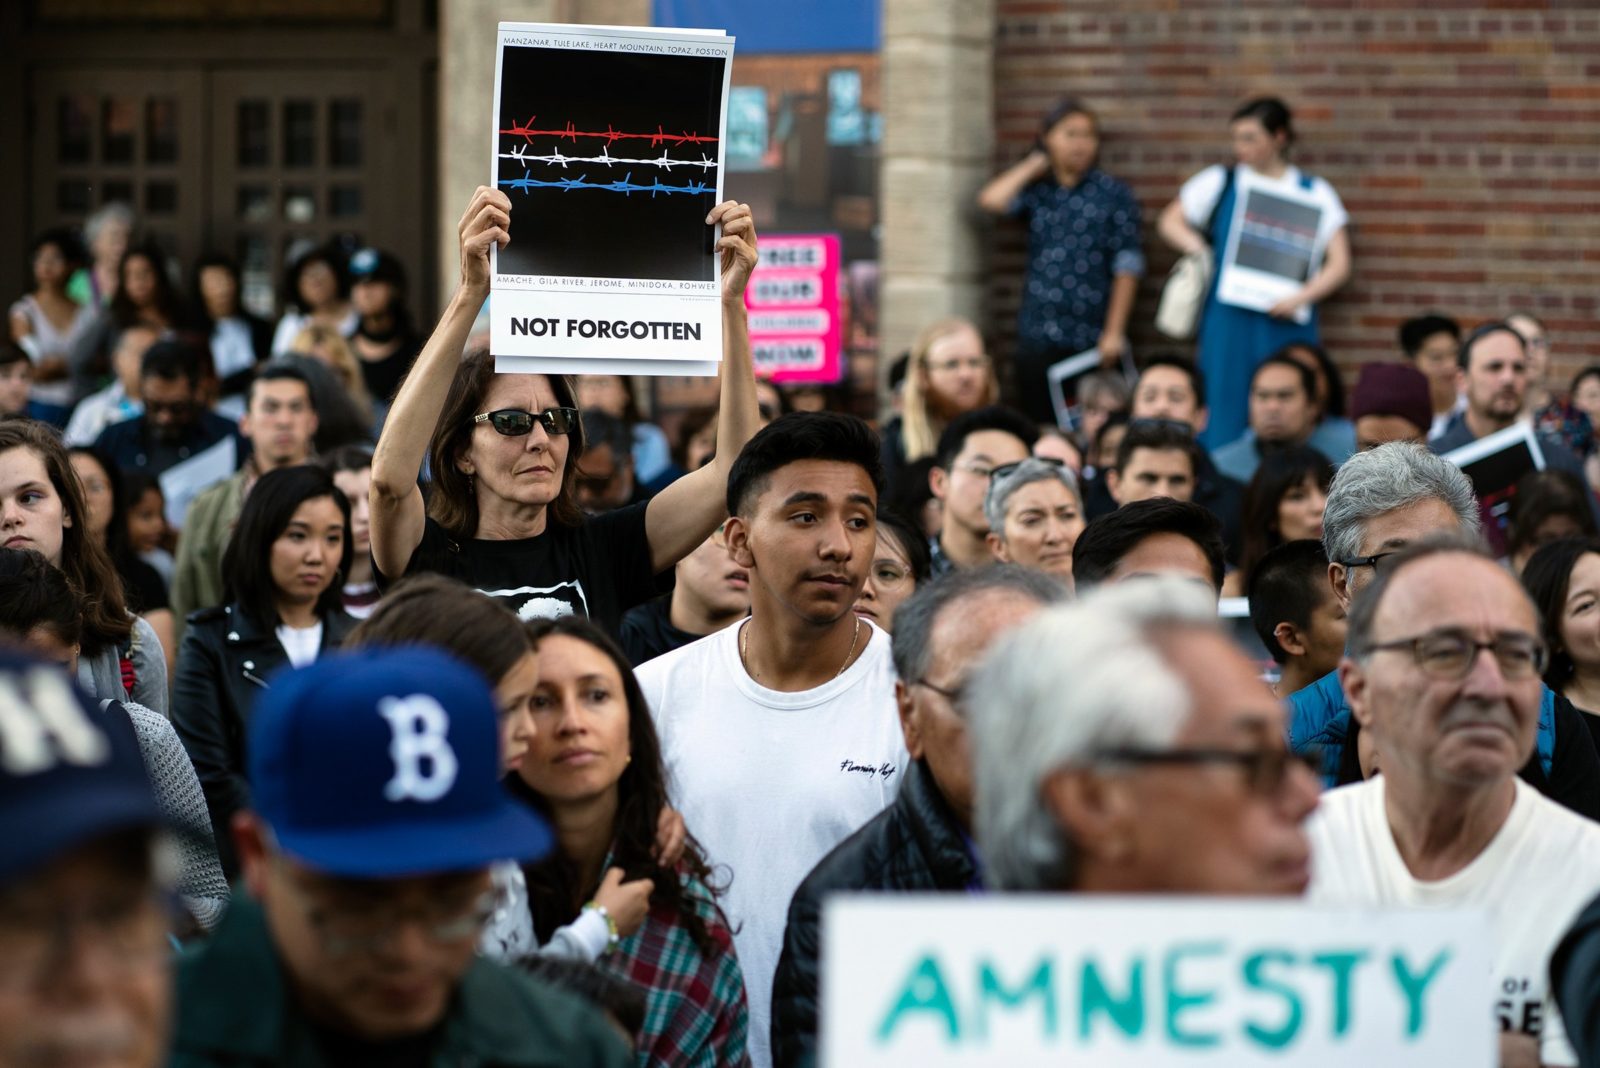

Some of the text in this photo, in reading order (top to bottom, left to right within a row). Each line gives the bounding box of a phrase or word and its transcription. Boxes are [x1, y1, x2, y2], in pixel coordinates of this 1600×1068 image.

[504, 37, 728, 56] MANZANAR, TULE LAKE, HEART MOUNTAIN, TOPAZ, POSTON
[497, 276, 715, 290] AMACHE, GILA RIVER, JEROME, MINIDOKA, ROHWER
[511, 317, 701, 341] NOT FORGOTTEN
[377, 693, 458, 802] B
[873, 941, 1454, 1048] AMNESTY
